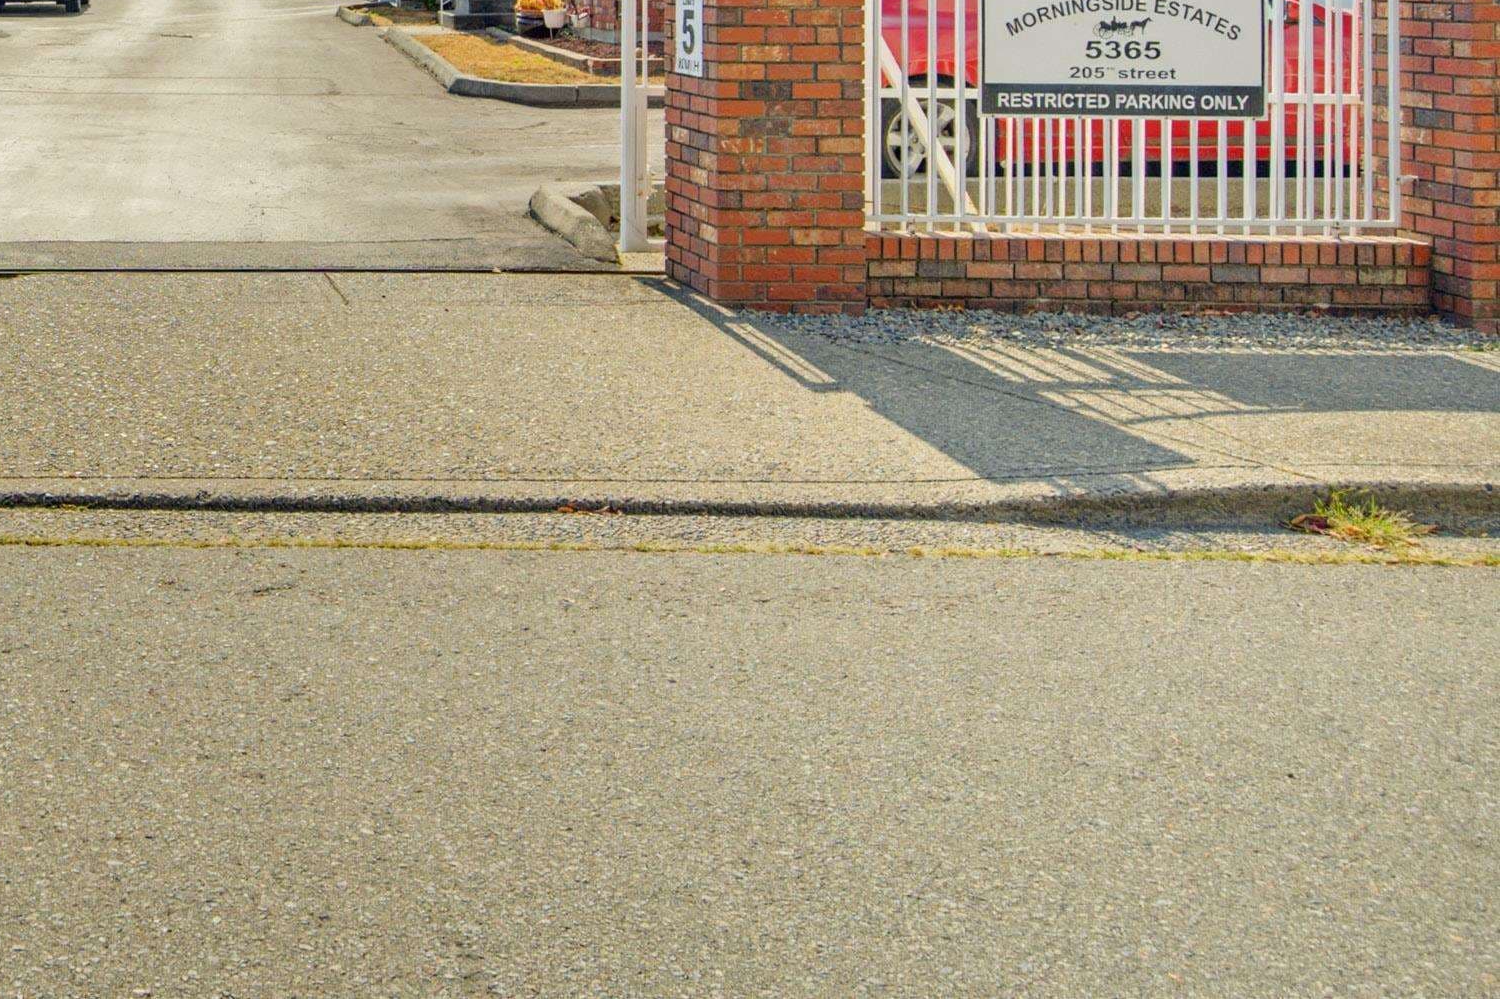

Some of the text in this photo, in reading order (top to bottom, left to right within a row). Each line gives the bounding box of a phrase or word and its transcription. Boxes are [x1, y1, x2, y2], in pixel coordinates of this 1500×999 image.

[1154, 0, 1242, 41] ESTATES
[682, 9, 695, 55] 5
[1085, 40, 1162, 60] 5365
[1118, 68, 1177, 80] street
[997, 92, 1249, 111] RESTRICTED PARKING ONLY
